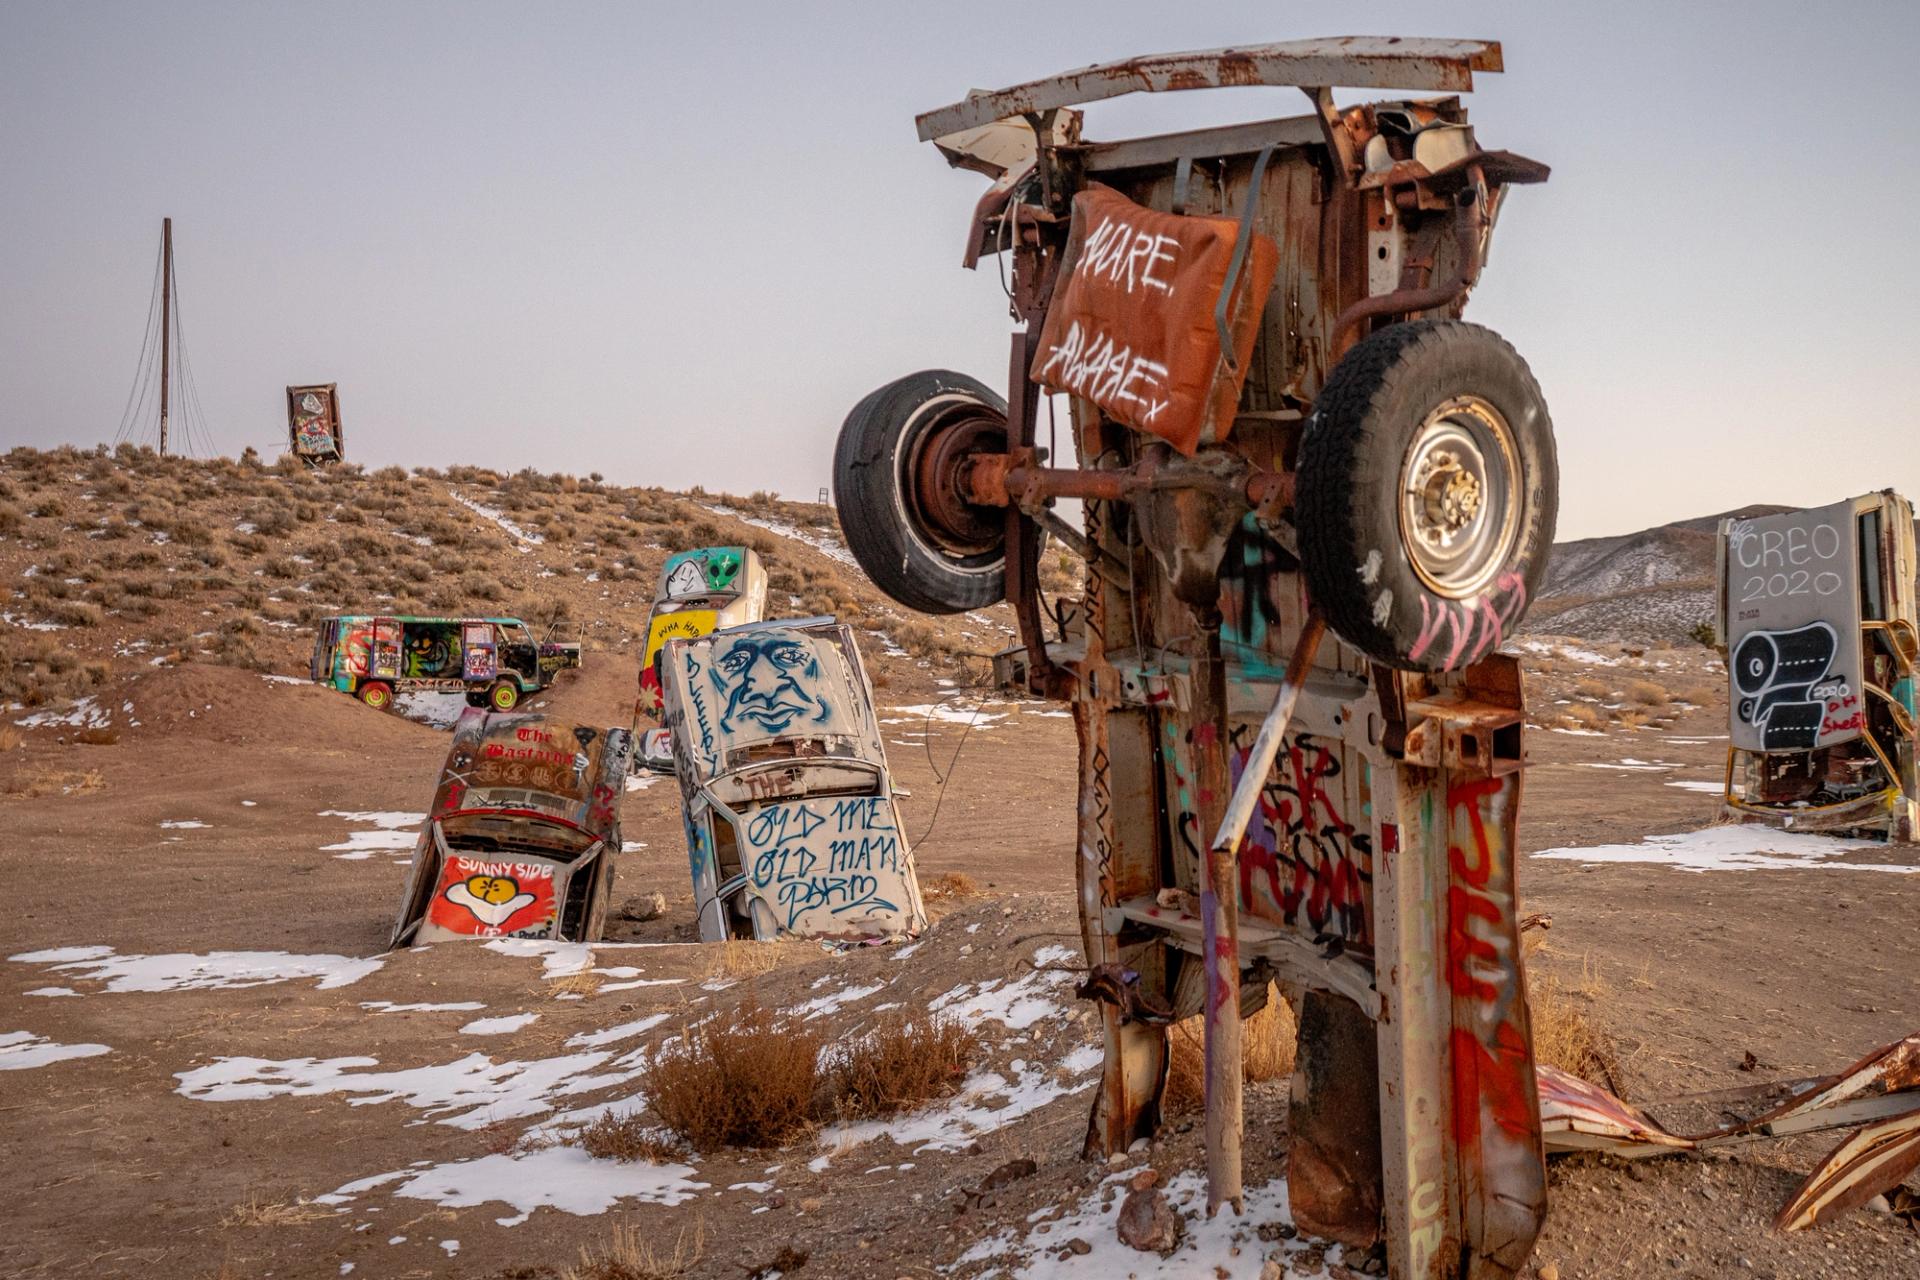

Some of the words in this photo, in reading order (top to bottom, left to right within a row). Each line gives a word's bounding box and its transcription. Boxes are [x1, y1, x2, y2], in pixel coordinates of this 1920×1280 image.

[1741, 570, 1841, 602] 2020
[658, 621, 679, 638] WHA
[1813, 684, 1849, 697] 2020
[517, 728, 552, 742] The
[745, 774, 794, 798] THE
[458, 856, 512, 877] SUNNY
[515, 862, 555, 880] SIDE
